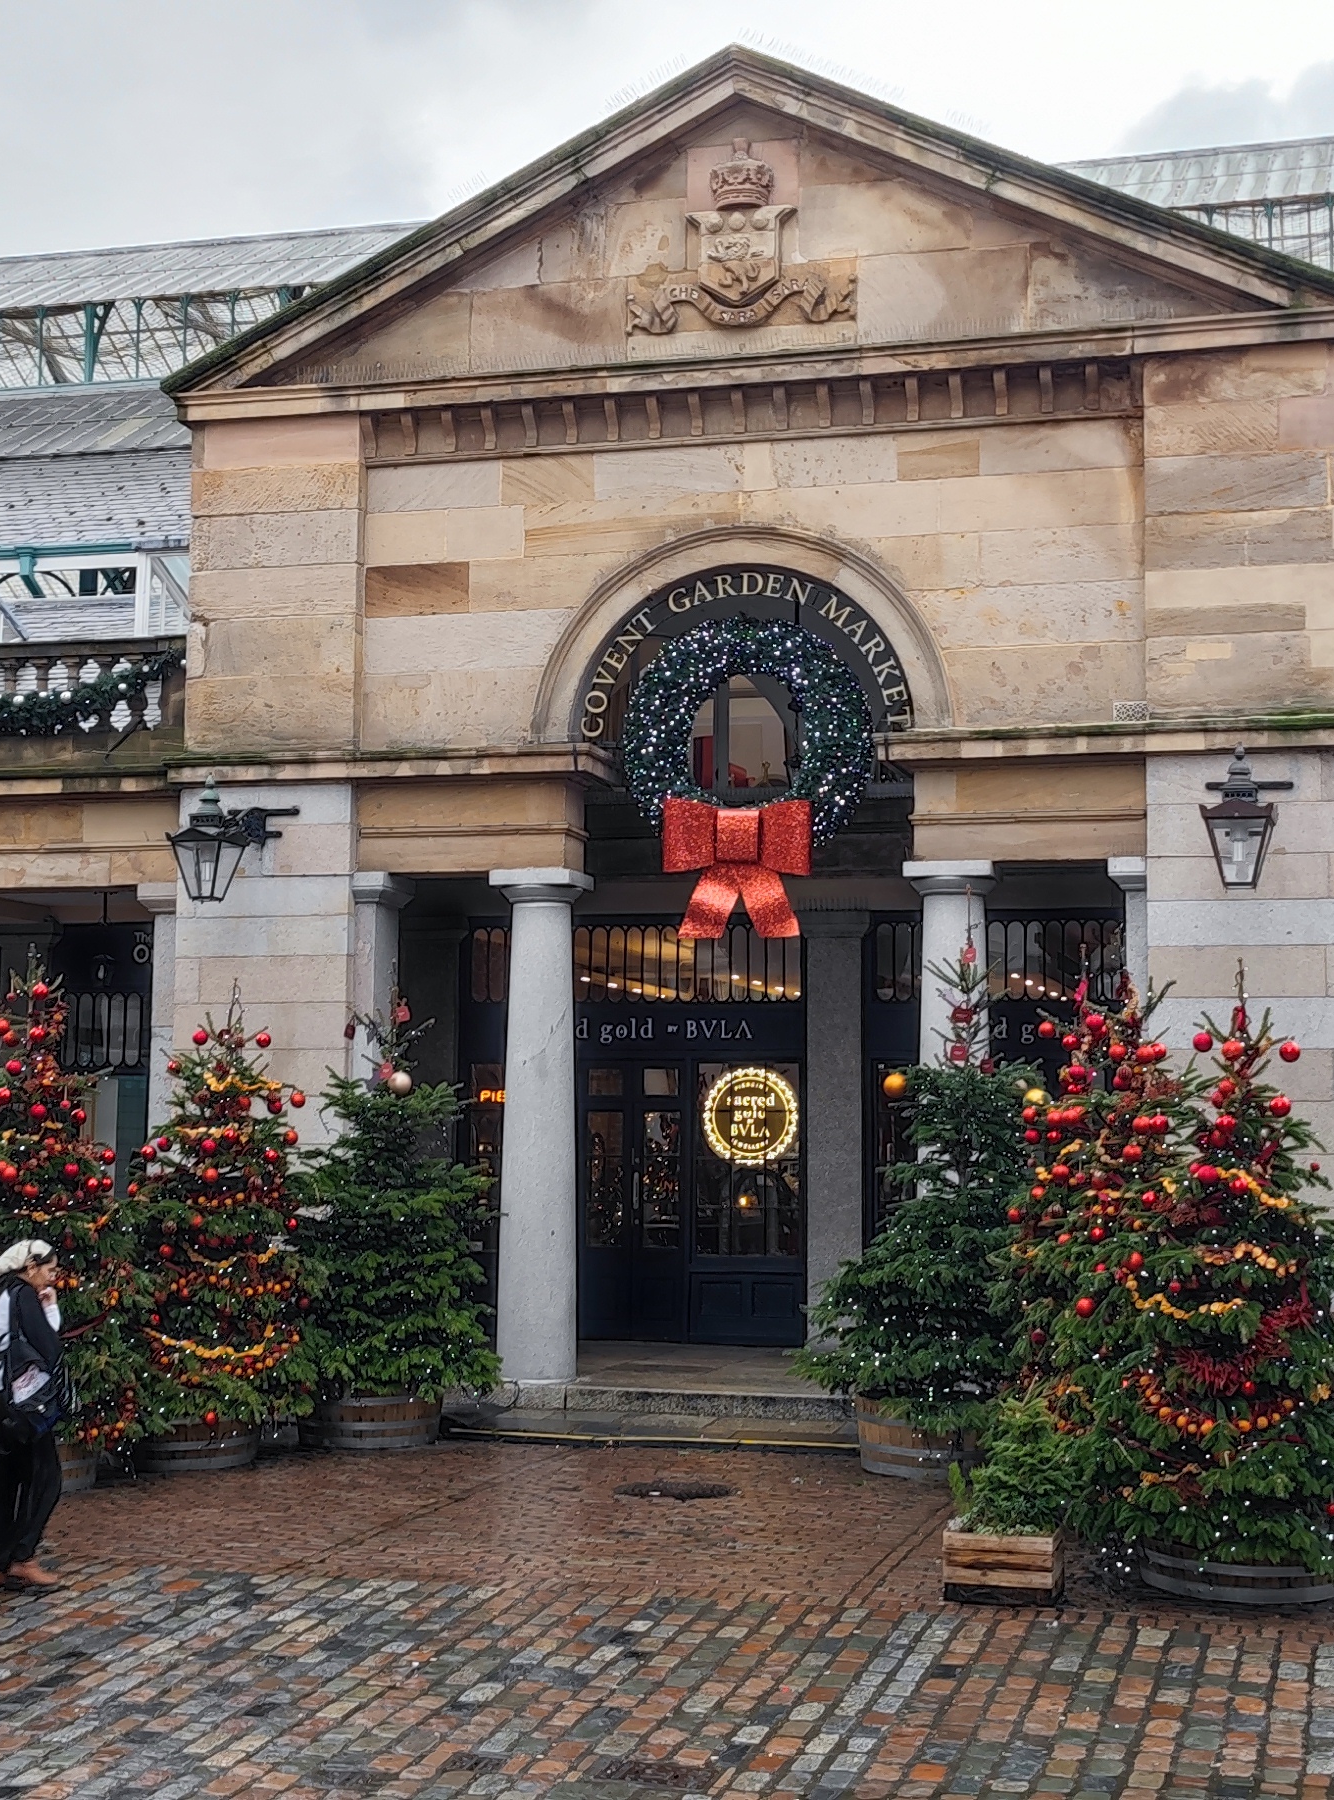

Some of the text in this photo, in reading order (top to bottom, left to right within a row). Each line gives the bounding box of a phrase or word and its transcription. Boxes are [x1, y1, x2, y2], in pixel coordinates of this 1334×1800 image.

[581, 571, 913, 737] COVENT GARDEN MARKET
[599, 1018, 654, 1043] gold
